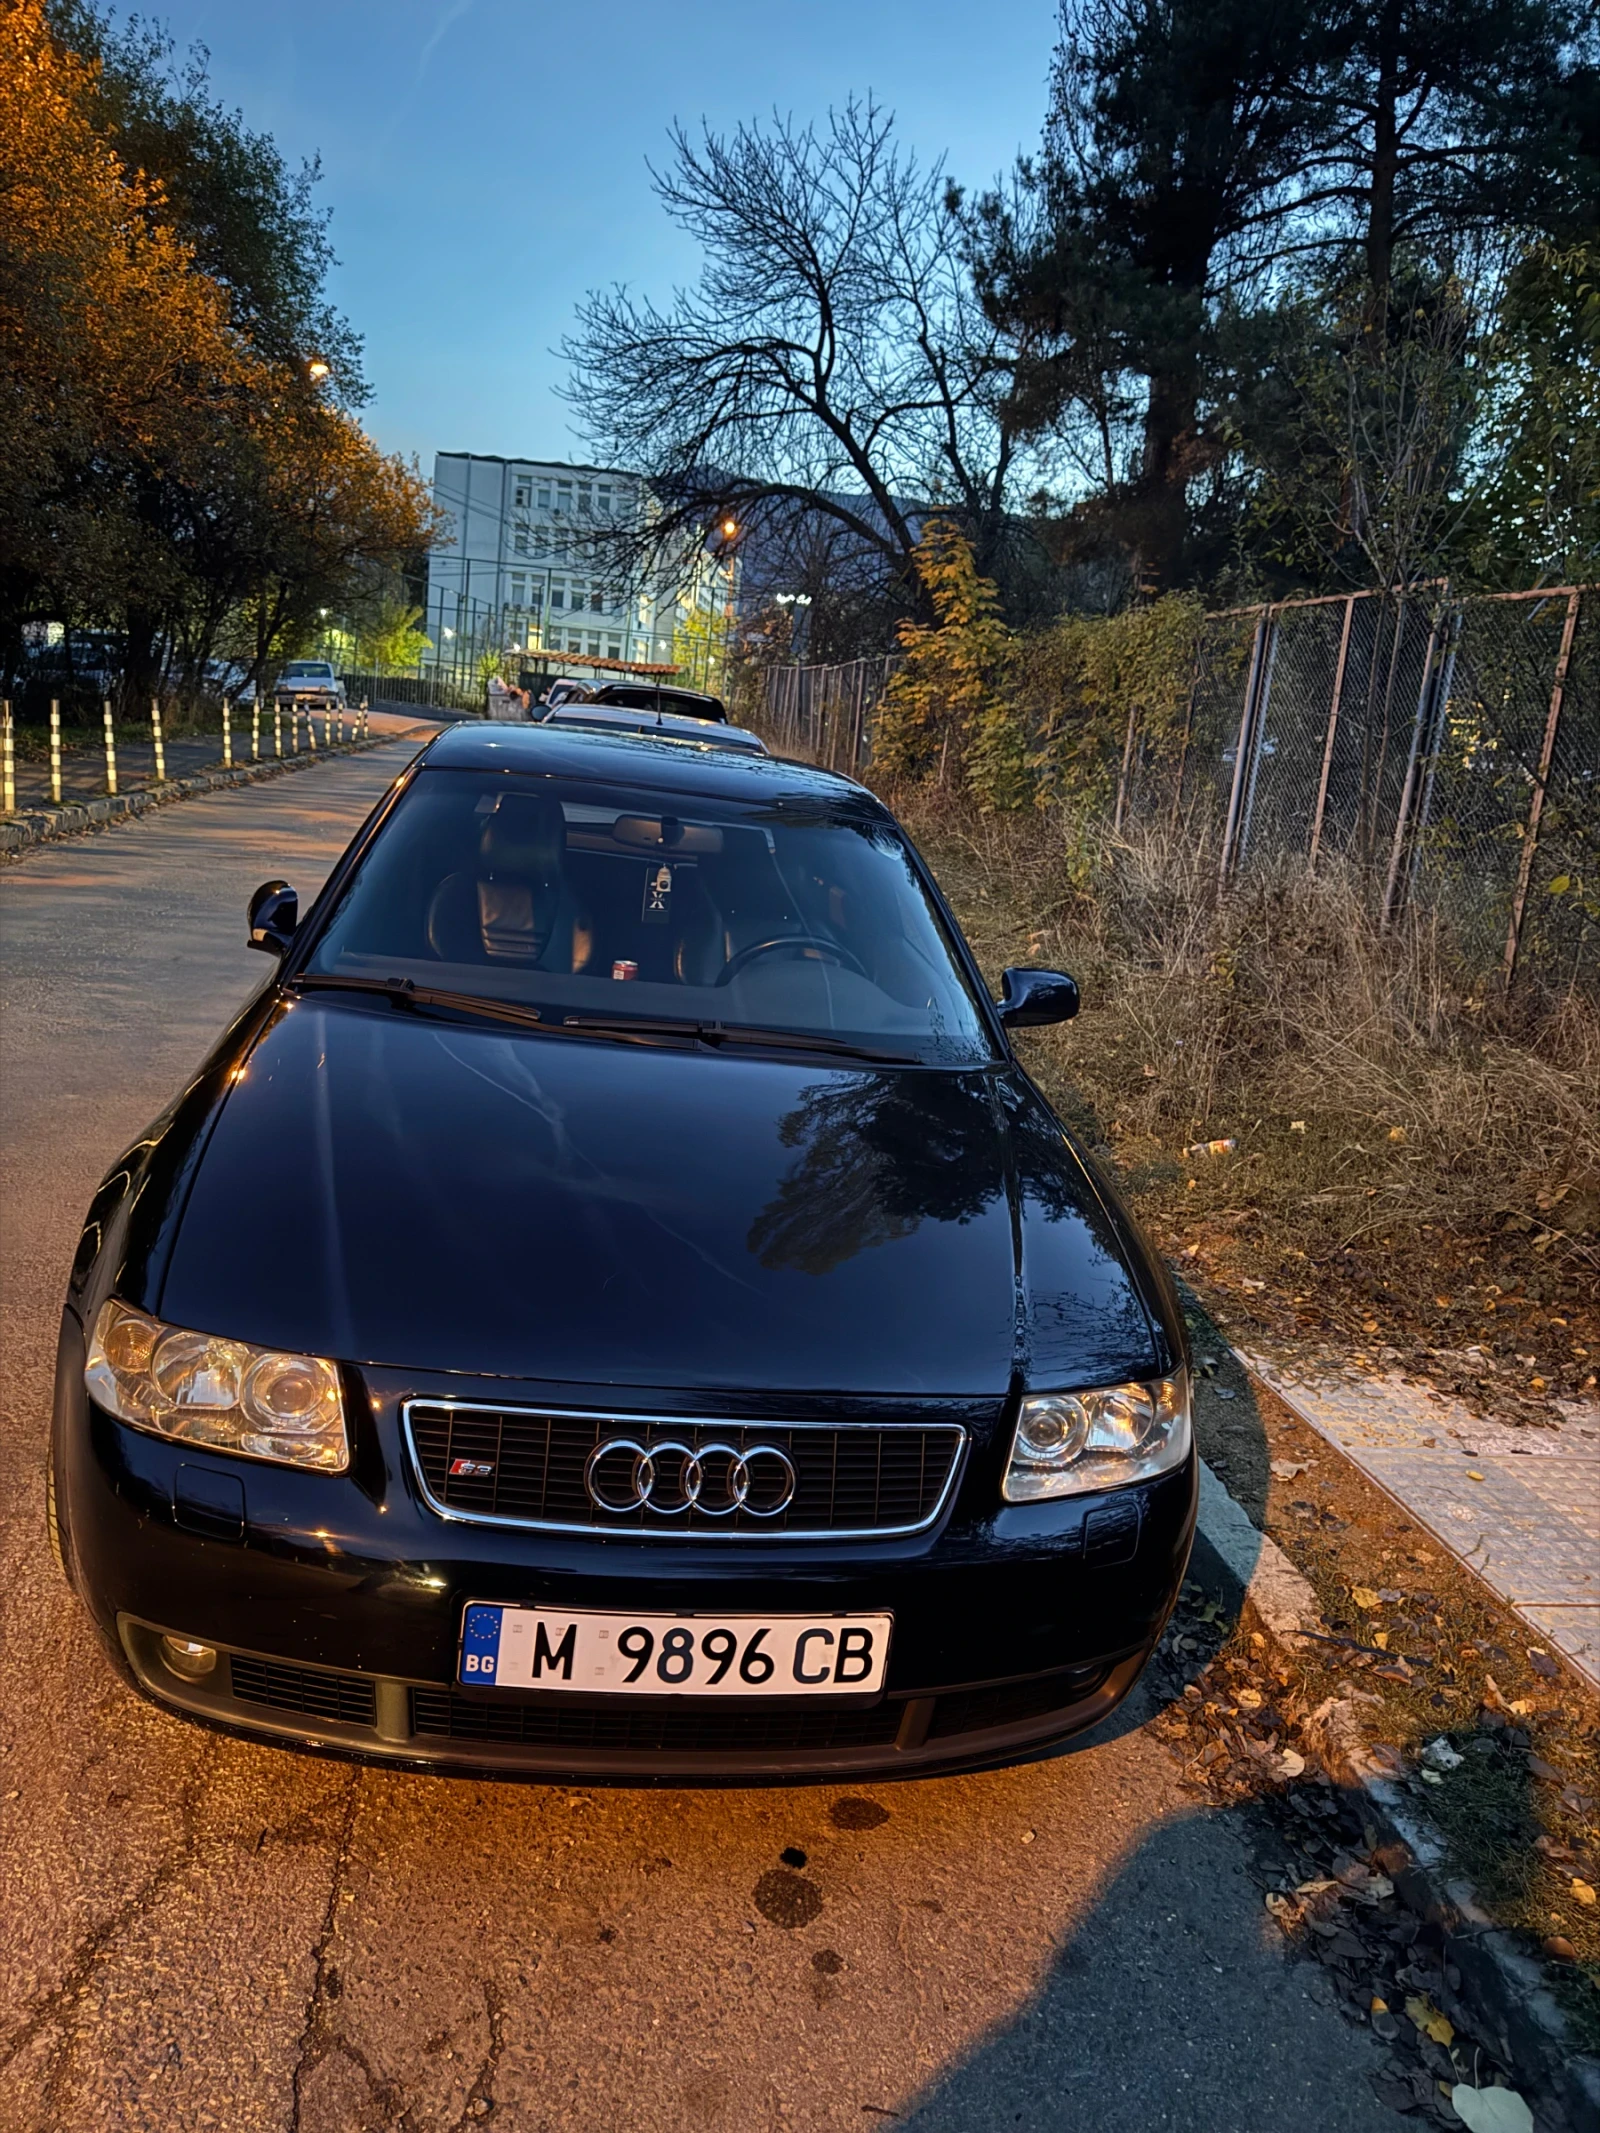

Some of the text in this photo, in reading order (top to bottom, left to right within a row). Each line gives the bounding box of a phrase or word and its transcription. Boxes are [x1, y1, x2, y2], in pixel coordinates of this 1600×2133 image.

[465, 1654, 495, 1674] BG
[532, 1621, 874, 1685] M 9896 CB
